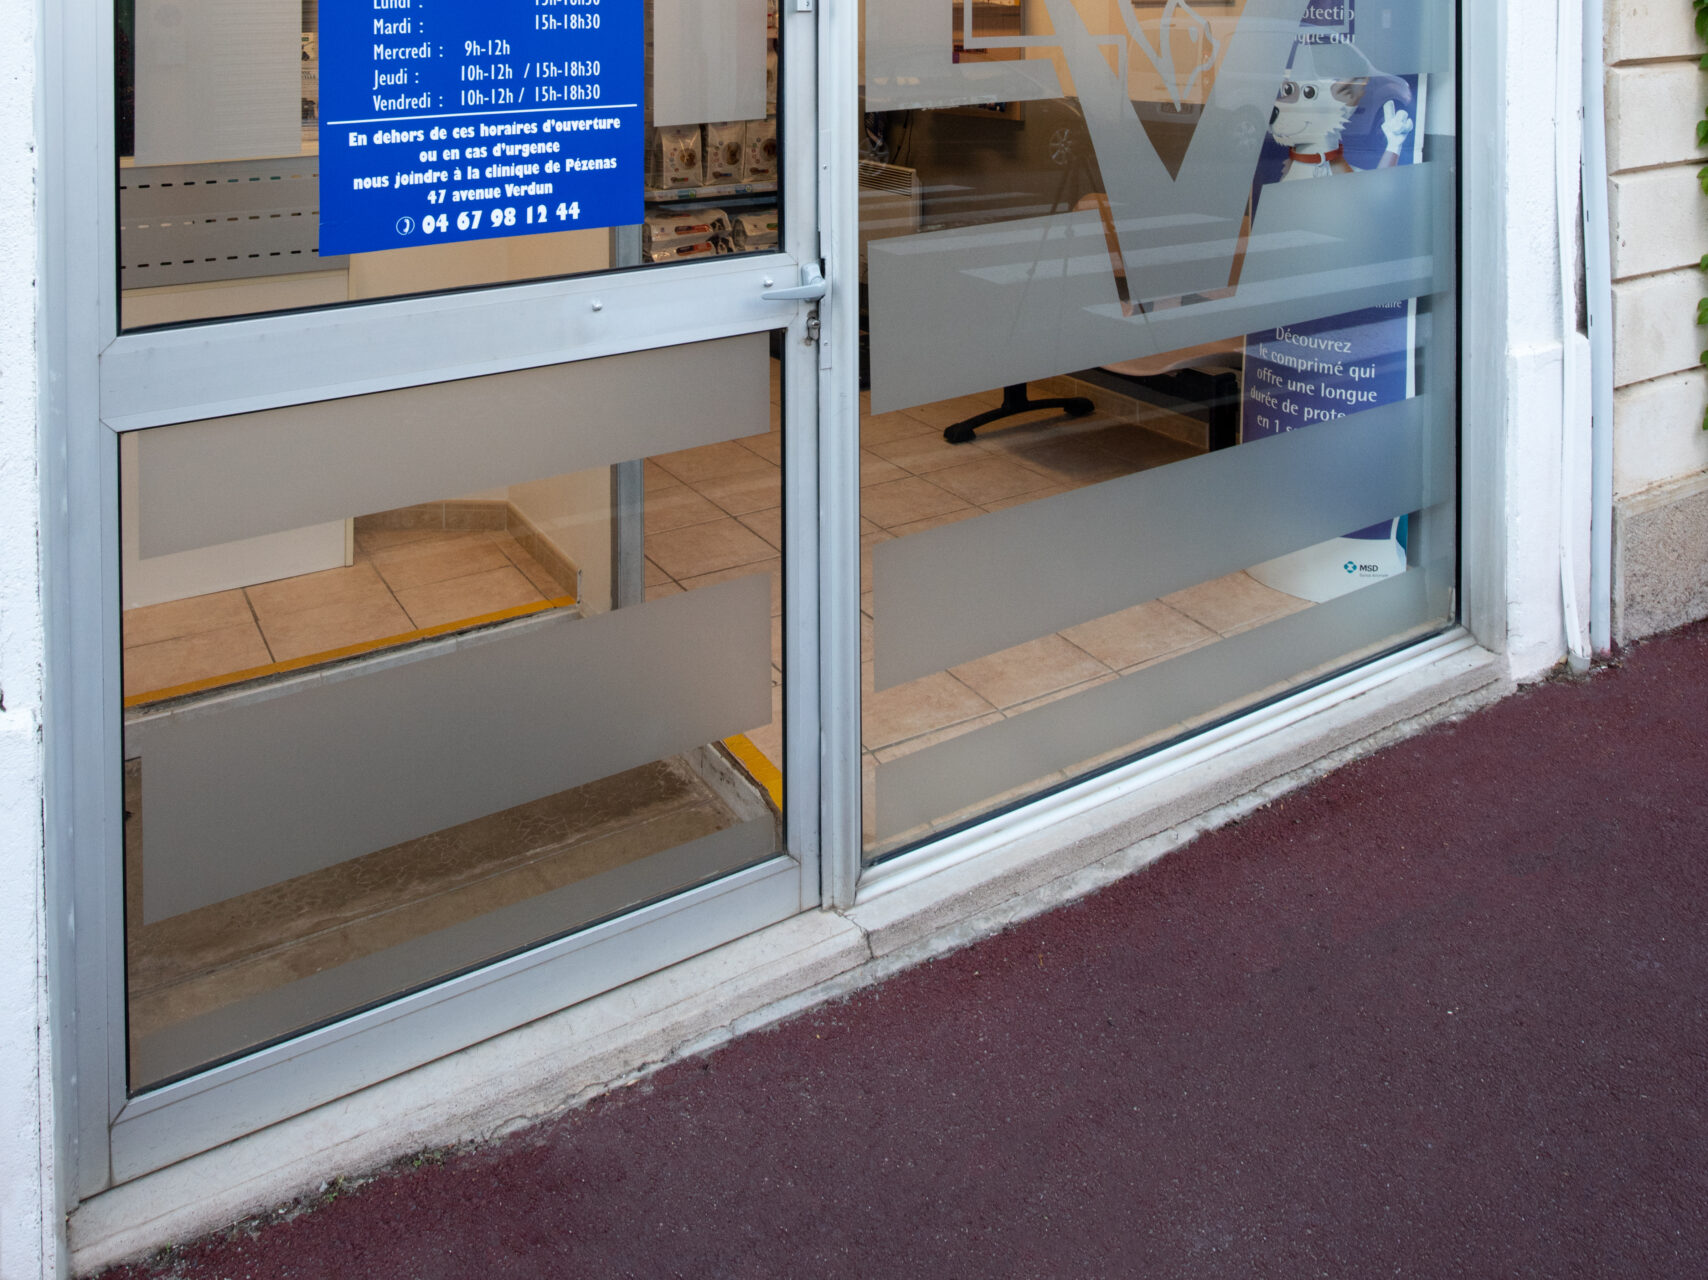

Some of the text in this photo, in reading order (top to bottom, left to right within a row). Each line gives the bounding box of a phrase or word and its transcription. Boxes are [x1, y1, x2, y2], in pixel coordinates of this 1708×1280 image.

[374, 18, 410, 34] Mardi
[536, 14, 600, 29] 15h-18h30
[374, 42, 430, 60] Mercredi
[465, 40, 509, 56] 9h-12h
[373, 69, 407, 90] Jeudi
[462, 64, 512, 80] 10h-12h
[537, 61, 600, 77] 15h-18h30
[373, 92, 430, 111] Vendredi
[536, 84, 600, 101] 15h-18h30
[349, 118, 620, 146] En dehors de ces horaires d'ouverture
[420, 142, 560, 162] ou en cas d'urgence
[354, 158, 616, 189] nous joindre à la clinique de Pézenas
[428, 182, 552, 204] 47 avenue Verdun
[422, 202, 580, 234] 04 67 98 12 44
[1275, 326, 1351, 354] Découvrez
[1259, 342, 1376, 379] le comprimé qui
[1256, 368, 1378, 403] offre une longue
[1250, 385, 1278, 409] durée
[1282, 399, 1299, 416] de
[1257, 414, 1270, 430] en
[1274, 419, 1280, 433] 1
[1360, 564, 1379, 572] MSD
